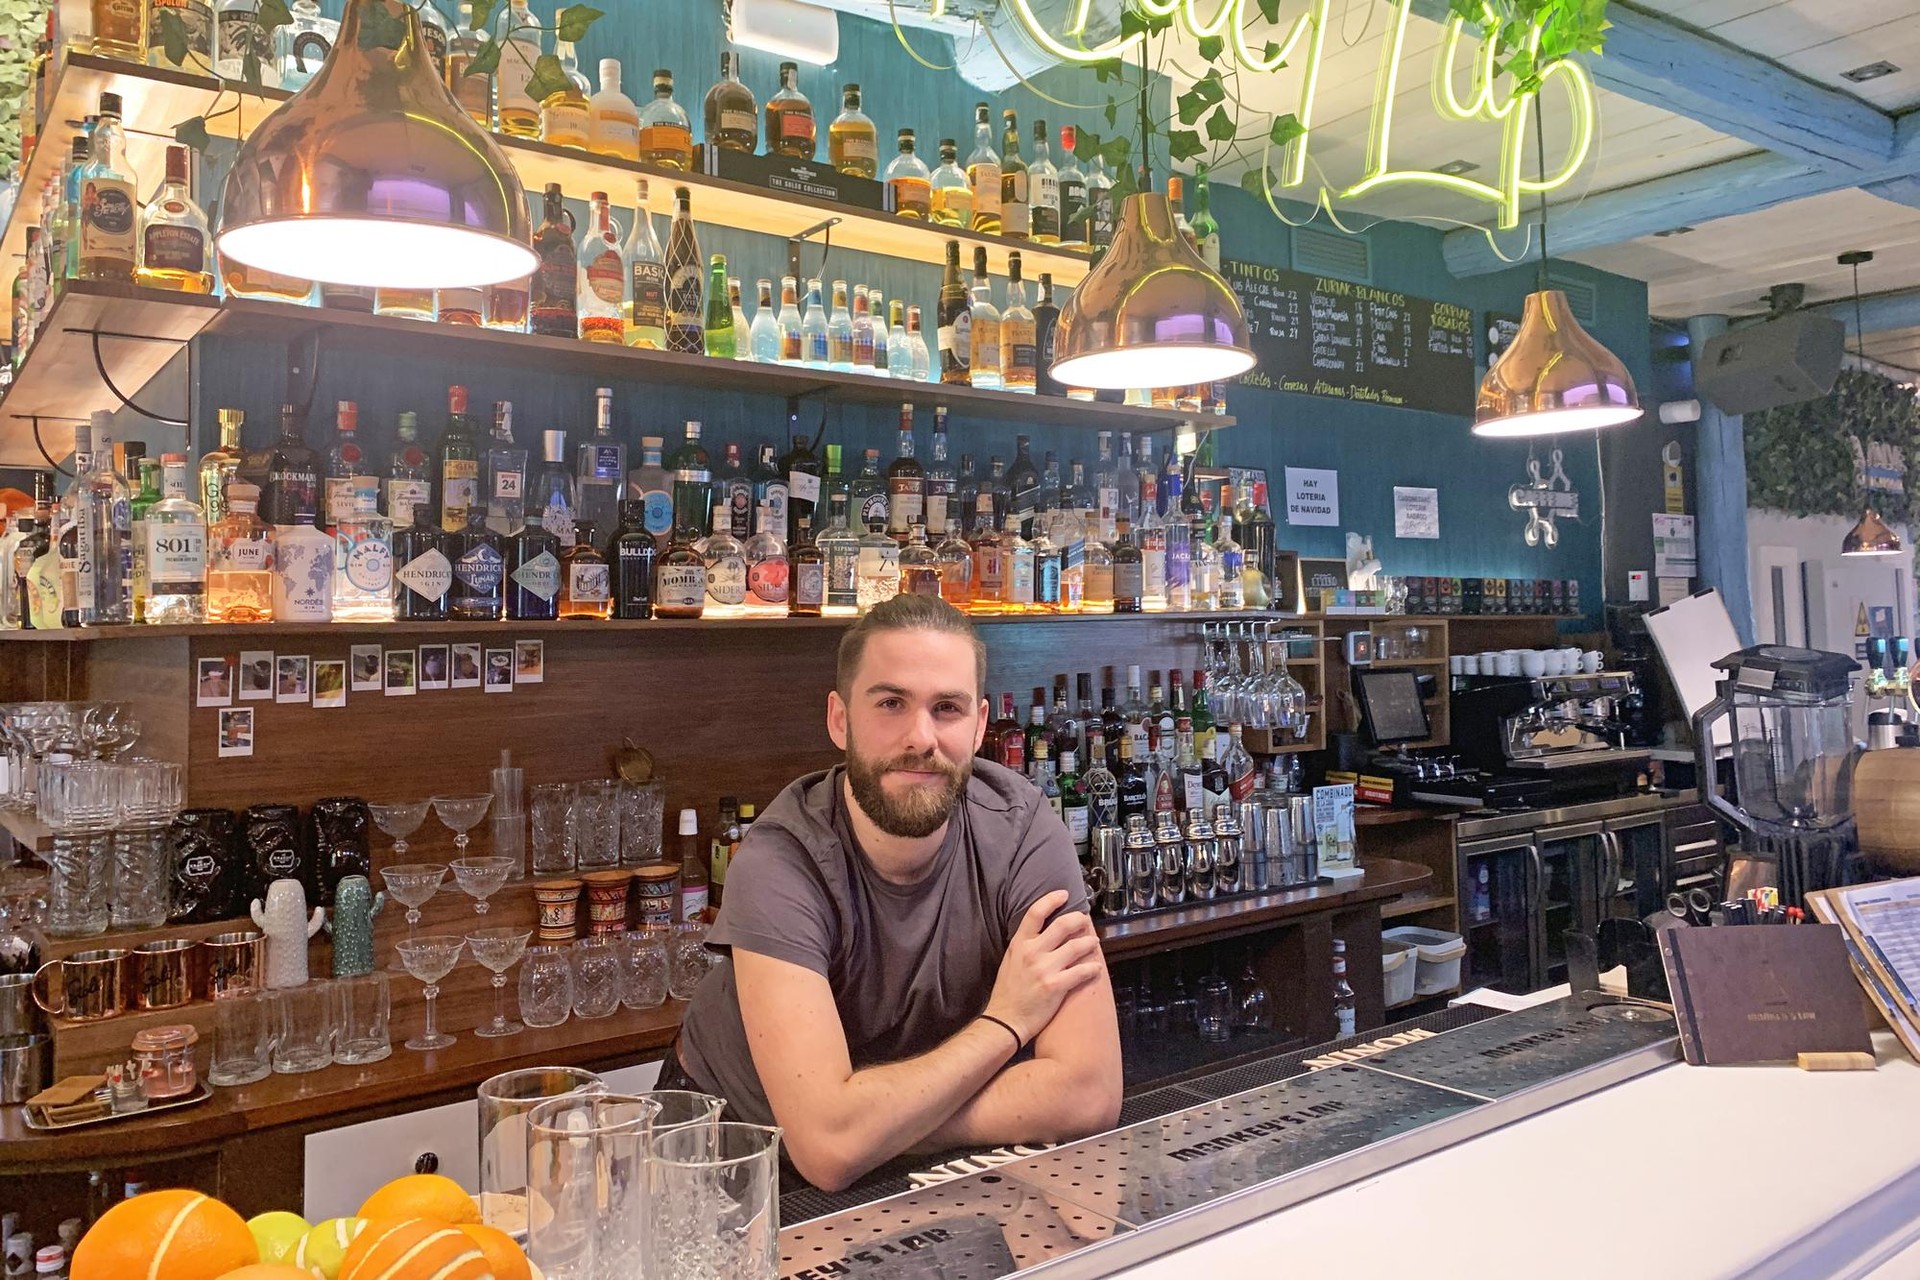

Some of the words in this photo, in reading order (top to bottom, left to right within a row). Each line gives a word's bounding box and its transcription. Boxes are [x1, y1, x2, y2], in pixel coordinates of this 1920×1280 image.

[772, 178, 784, 187] THE
[803, 184, 837, 198] COLLECTION
[501, 478, 516, 491] 24
[1303, 479, 1318, 488] HAY
[1296, 492, 1326, 502] LOTERIA
[1290, 505, 1300, 513] DE
[1301, 505, 1332, 514] NAVIDAD
[238, 548, 260, 556] JUNE
[352, 543, 391, 560] MALFY
[1316, 786, 1353, 800] COMBINADO
[1166, 1114, 1307, 1162] MONKEY'S
